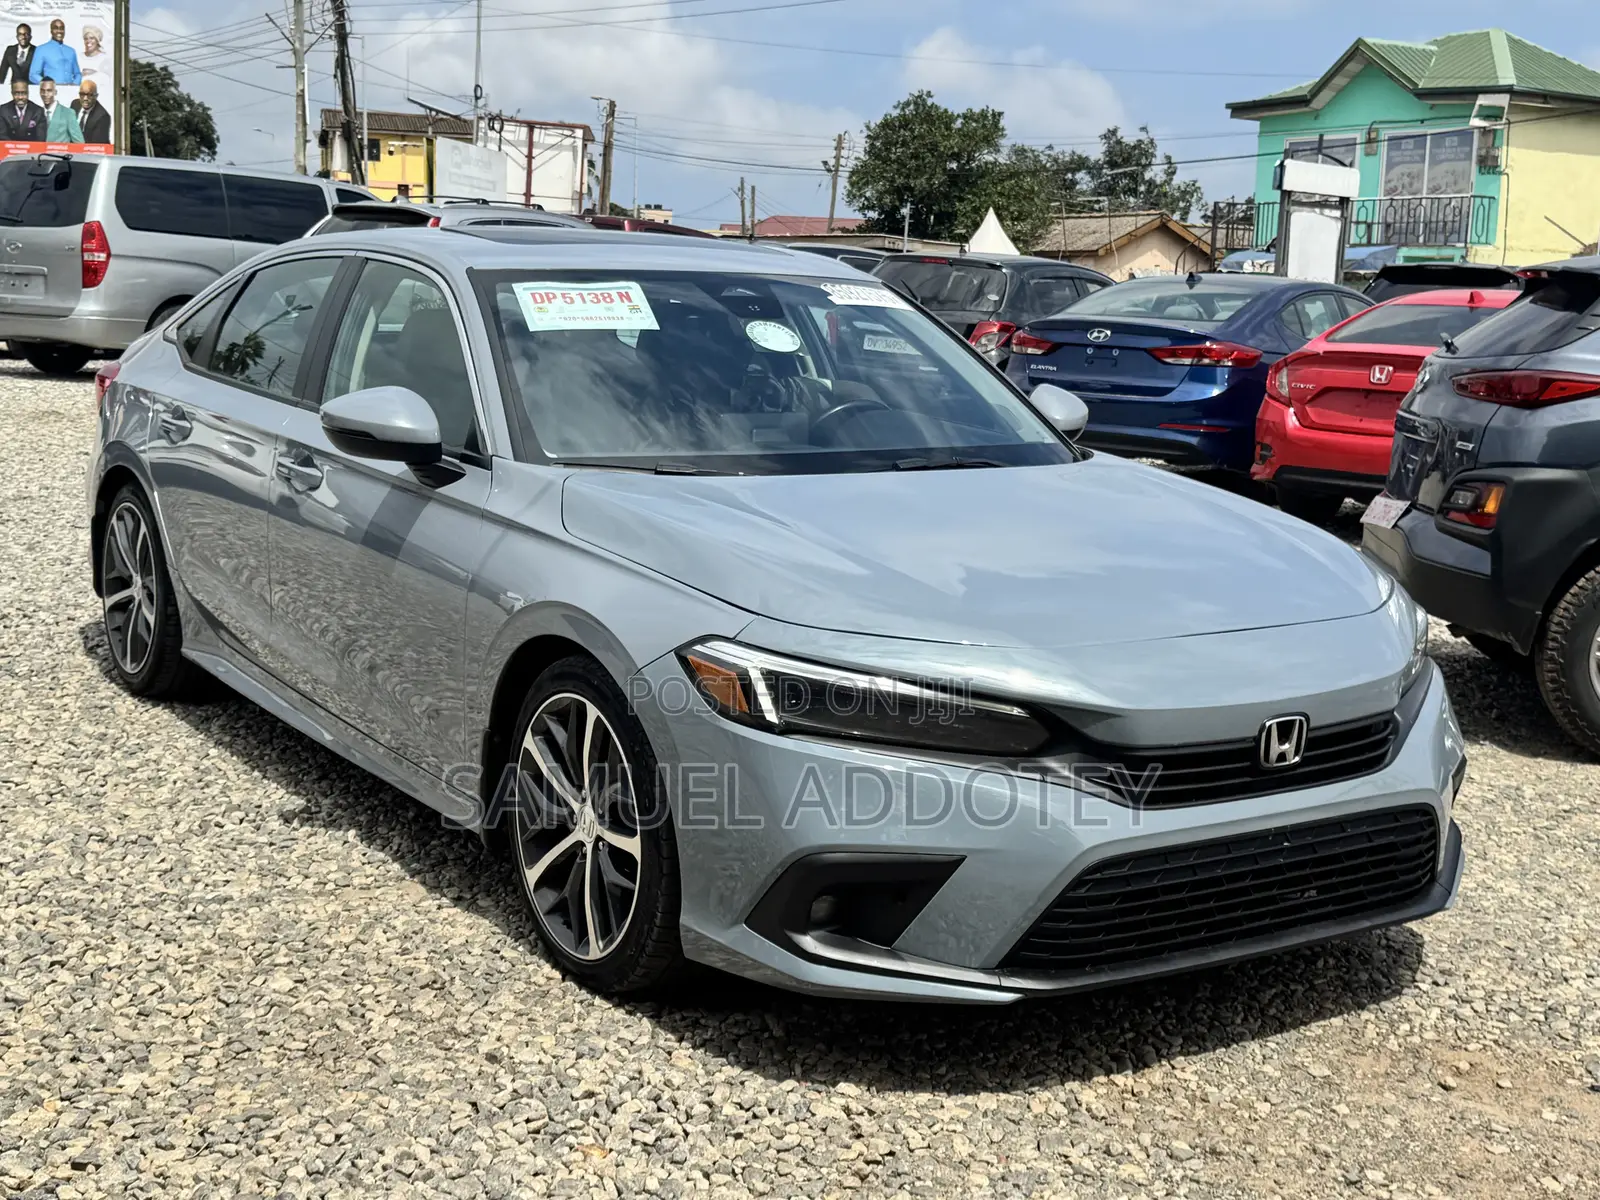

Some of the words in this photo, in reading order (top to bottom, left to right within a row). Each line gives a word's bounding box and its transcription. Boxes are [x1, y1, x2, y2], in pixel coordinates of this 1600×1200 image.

[530, 292, 557, 305] DP
[560, 292, 615, 305] 5138
[616, 291, 633, 303] N
[1030, 364, 1057, 372] ELANTRA
[1291, 382, 1316, 390] CIVIC
